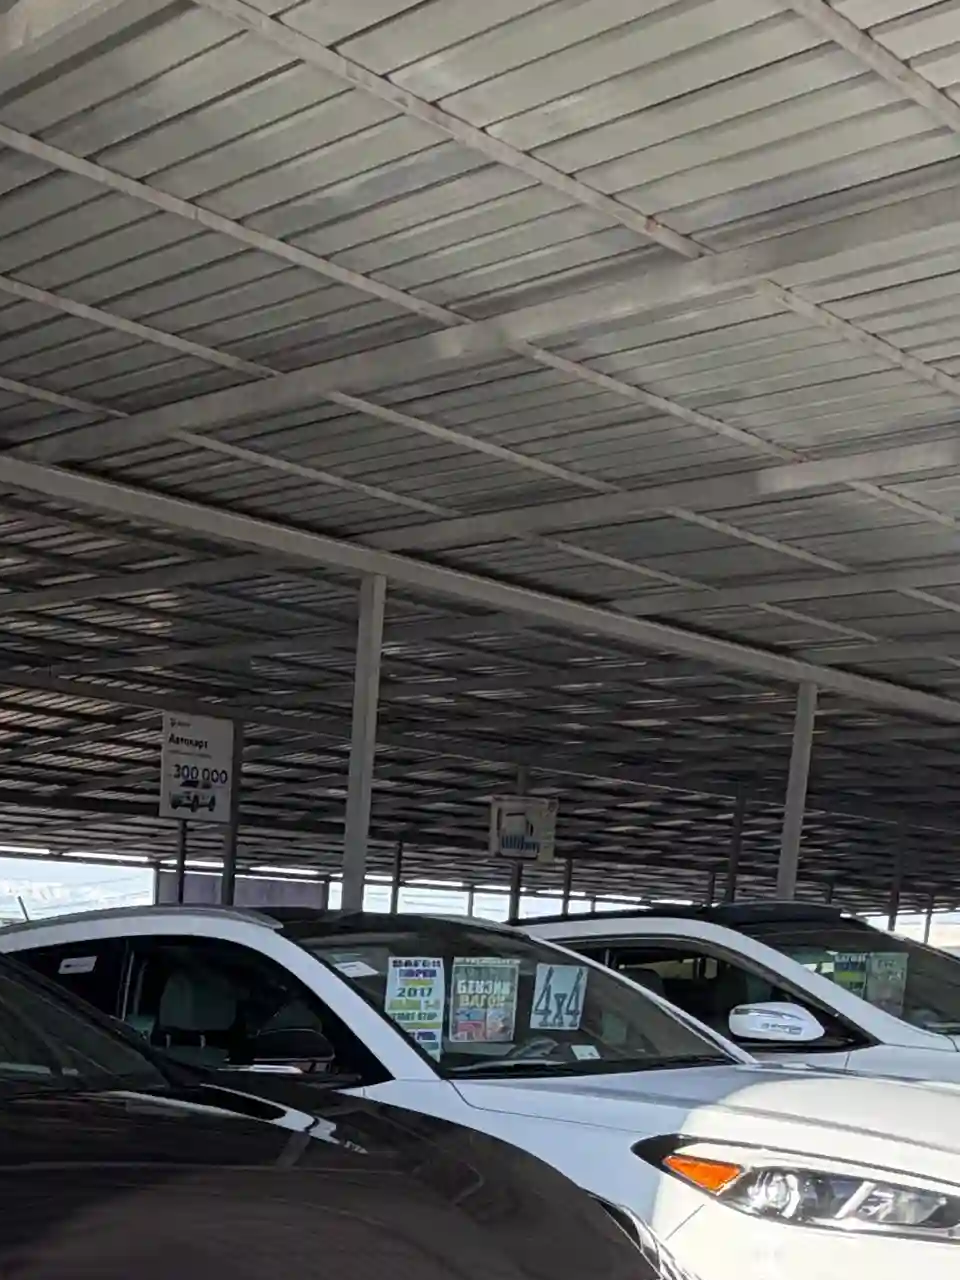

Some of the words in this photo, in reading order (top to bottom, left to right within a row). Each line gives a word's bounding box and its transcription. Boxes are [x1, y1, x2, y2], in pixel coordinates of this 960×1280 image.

[172, 764, 199, 780] 300
[202, 768, 228, 784] 000
[397, 987, 433, 998] 2017
